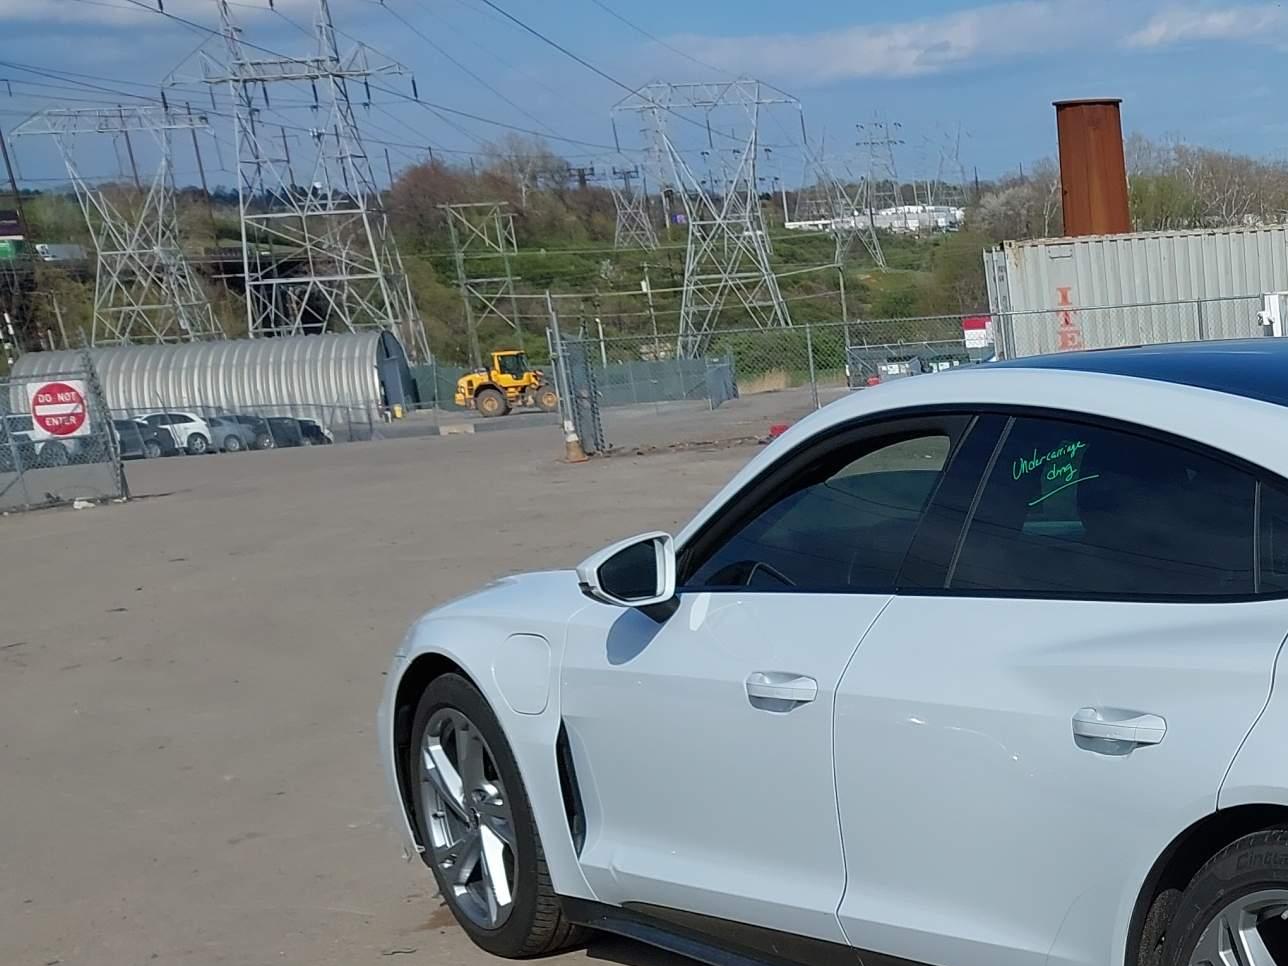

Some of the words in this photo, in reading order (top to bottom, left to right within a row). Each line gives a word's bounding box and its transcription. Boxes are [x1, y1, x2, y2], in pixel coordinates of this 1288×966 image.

[38, 393, 52, 403] DO
[57, 391, 76, 403] NOT
[45, 415, 77, 426] ENTER
